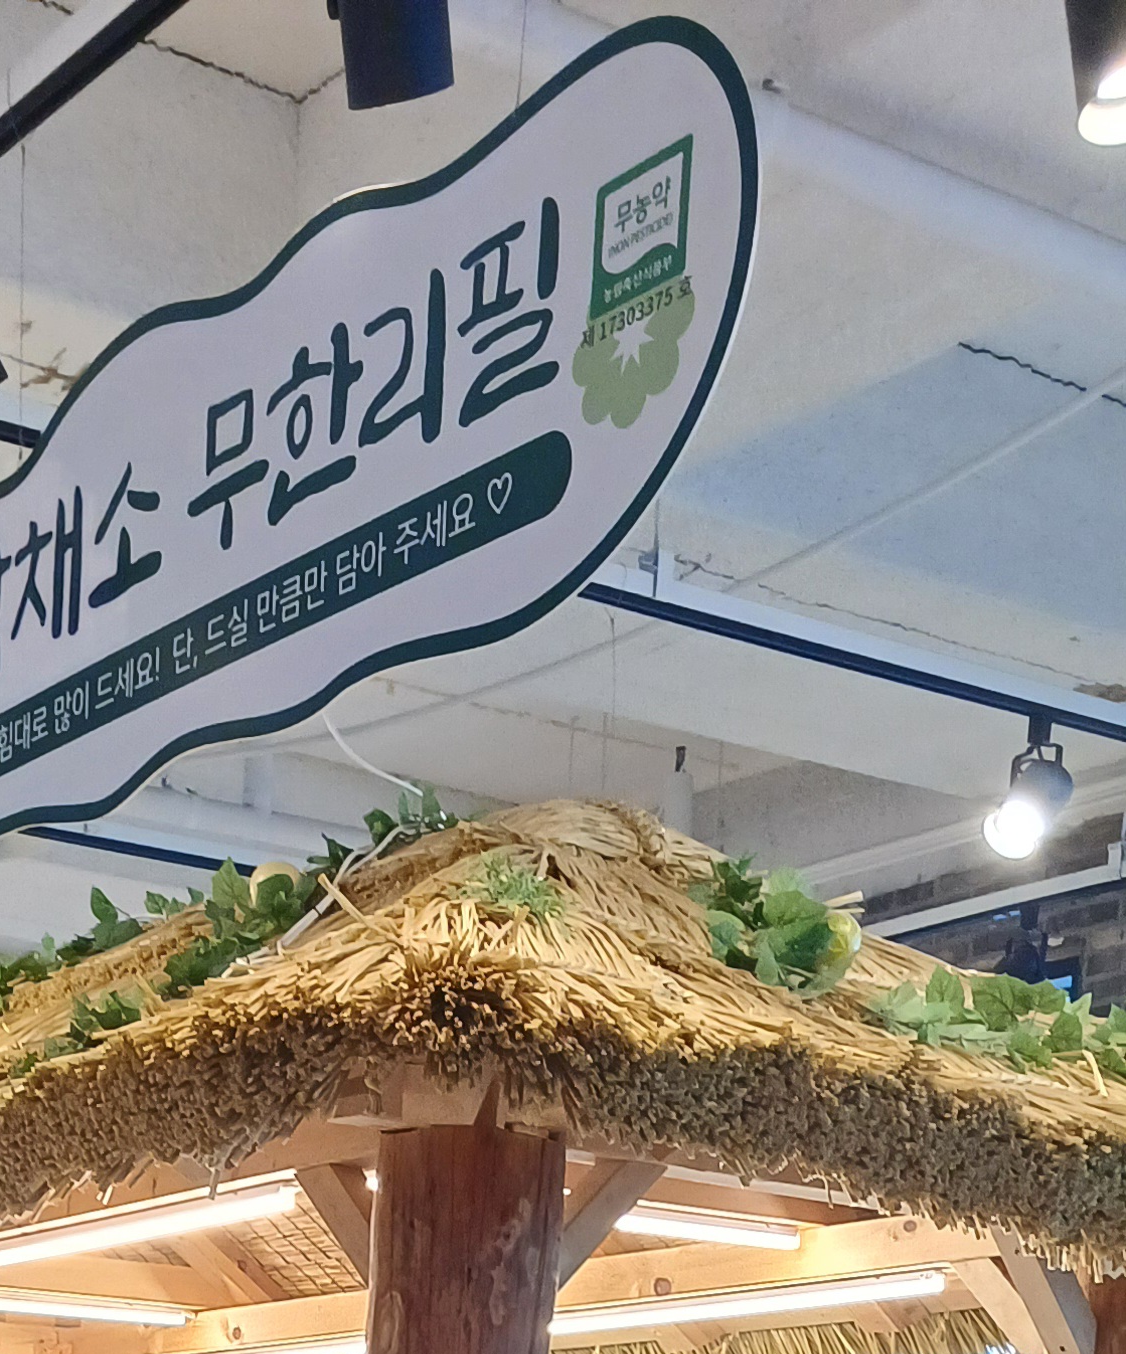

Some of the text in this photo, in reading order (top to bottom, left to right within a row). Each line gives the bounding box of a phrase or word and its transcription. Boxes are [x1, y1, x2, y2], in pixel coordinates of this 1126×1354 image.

[614, 175, 671, 232] 무농약
[187, 197, 560, 550] 무한리필
[581, 274, 693, 349] 제 17303375 호
[52, 683, 90, 735] 많이
[95, 655, 162, 708] 드세요!
[172, 625, 199, 673] 단,
[204, 599, 249, 659] 드실
[255, 565, 328, 632] 만큼만
[334, 535, 386, 594] 담아
[393, 492, 476, 566] 주세요
